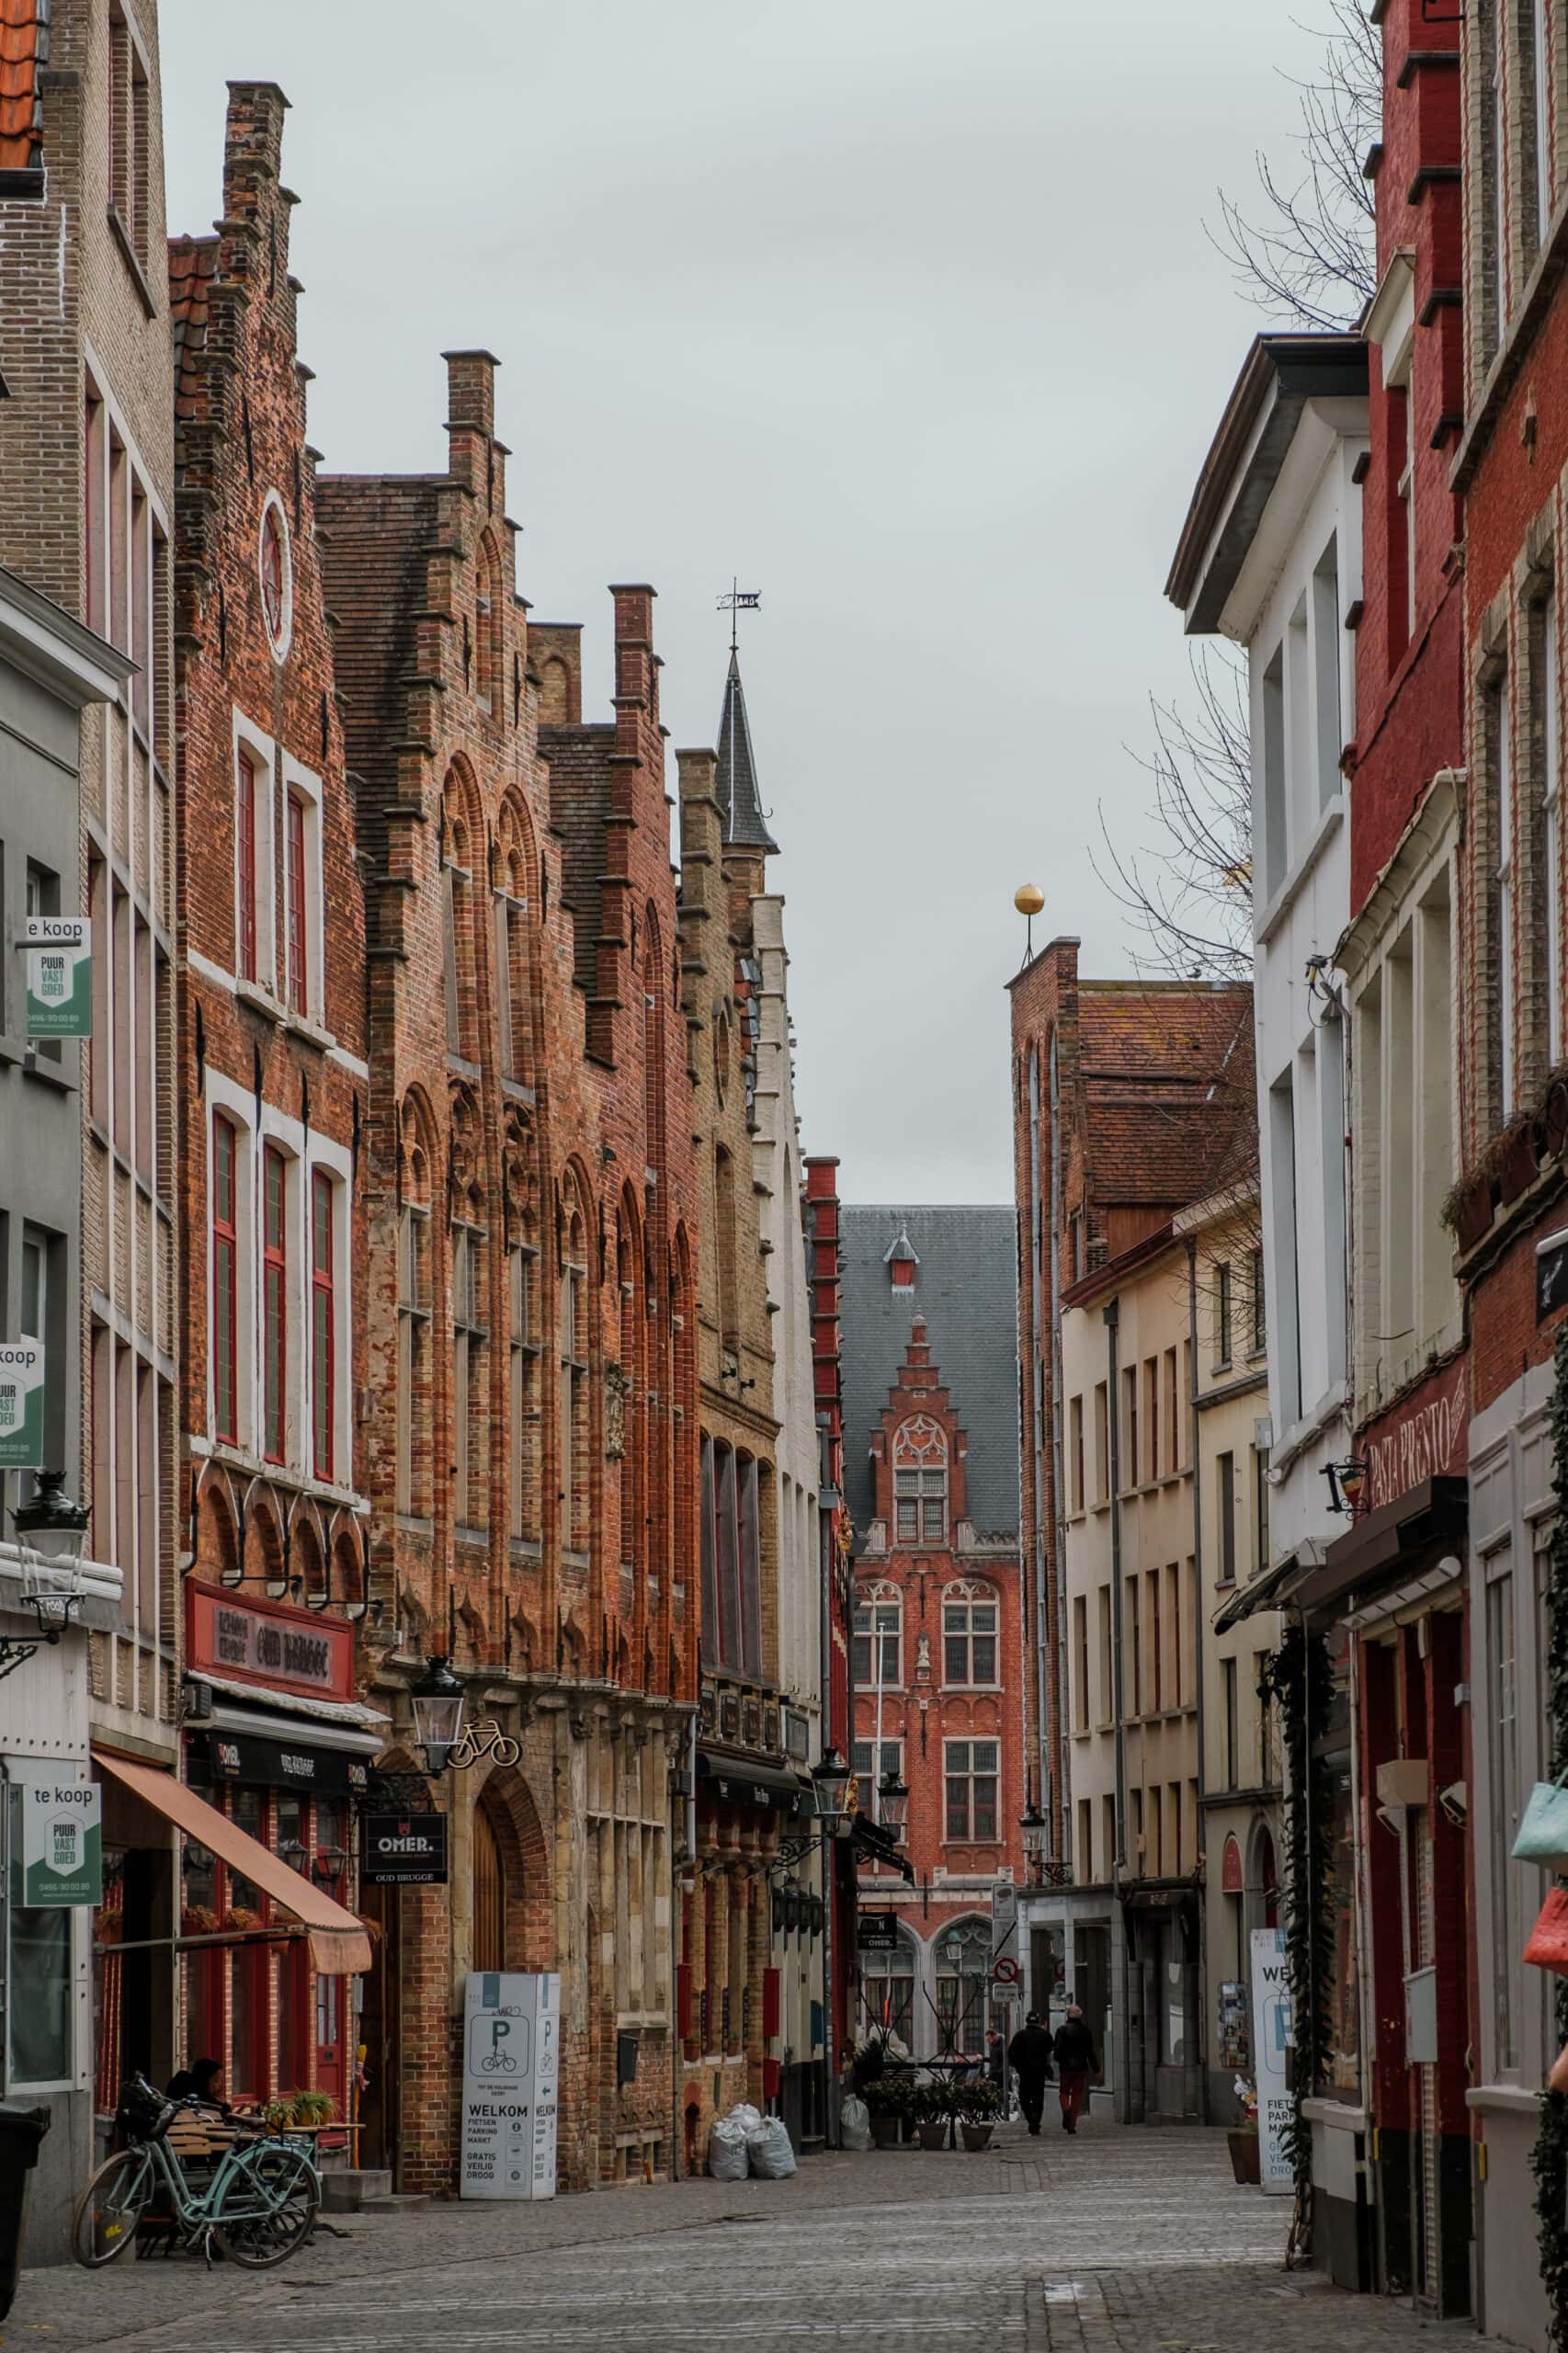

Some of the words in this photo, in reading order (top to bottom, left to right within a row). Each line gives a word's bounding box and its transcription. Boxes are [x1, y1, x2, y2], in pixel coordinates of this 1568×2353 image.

[43, 920, 83, 938] koop
[41, 957, 64, 969] PUUR
[41, 971, 63, 982] VAST
[41, 983, 64, 995] GOED
[1400, 1396, 1450, 1493] PRESTO
[35, 1789, 50, 1802] te
[55, 1787, 93, 1807] koop
[53, 1824, 75, 1836] PUUR
[54, 1838, 74, 1850] VAST
[378, 1836, 434, 1852] OMER.
[54, 1851, 75, 1864] GOED
[375, 1874, 395, 1882] OUD
[397, 1873, 434, 1881] BRUGGE
[469, 2104, 528, 2118] WELKOM
[536, 2103, 556, 2118] WELKOM
[468, 2118, 496, 2126] FIETSEN
[468, 2127, 497, 2135] PARKING
[467, 2136, 491, 2144] MARKT
[467, 2153, 496, 2161] GRATIS
[467, 2162, 494, 2170] VEILIG
[467, 2171, 494, 2179] DROOG
